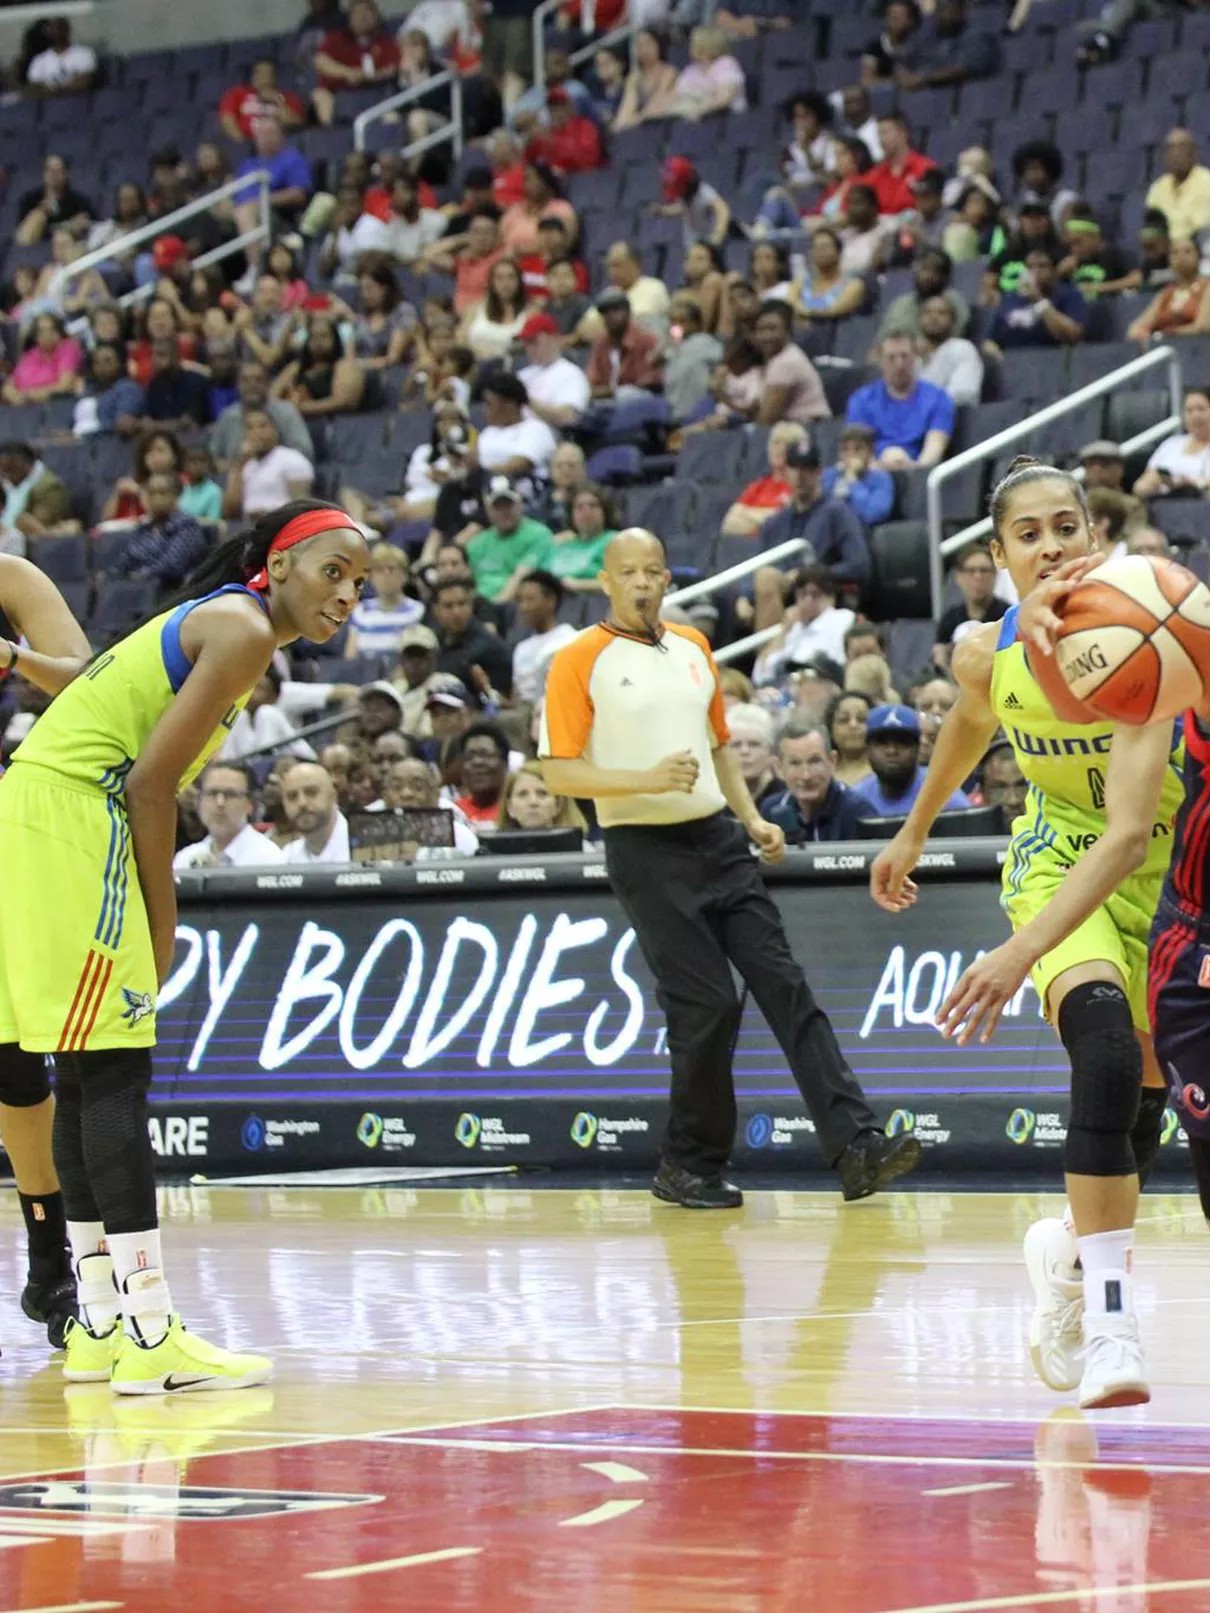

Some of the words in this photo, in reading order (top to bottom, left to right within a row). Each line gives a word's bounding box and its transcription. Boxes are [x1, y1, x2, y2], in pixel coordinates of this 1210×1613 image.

[813, 855, 866, 869] WGL.COM
[259, 912, 645, 1070] BODIES
[915, 1113, 941, 1128] WGL
[1036, 1113, 1062, 1127] WGL
